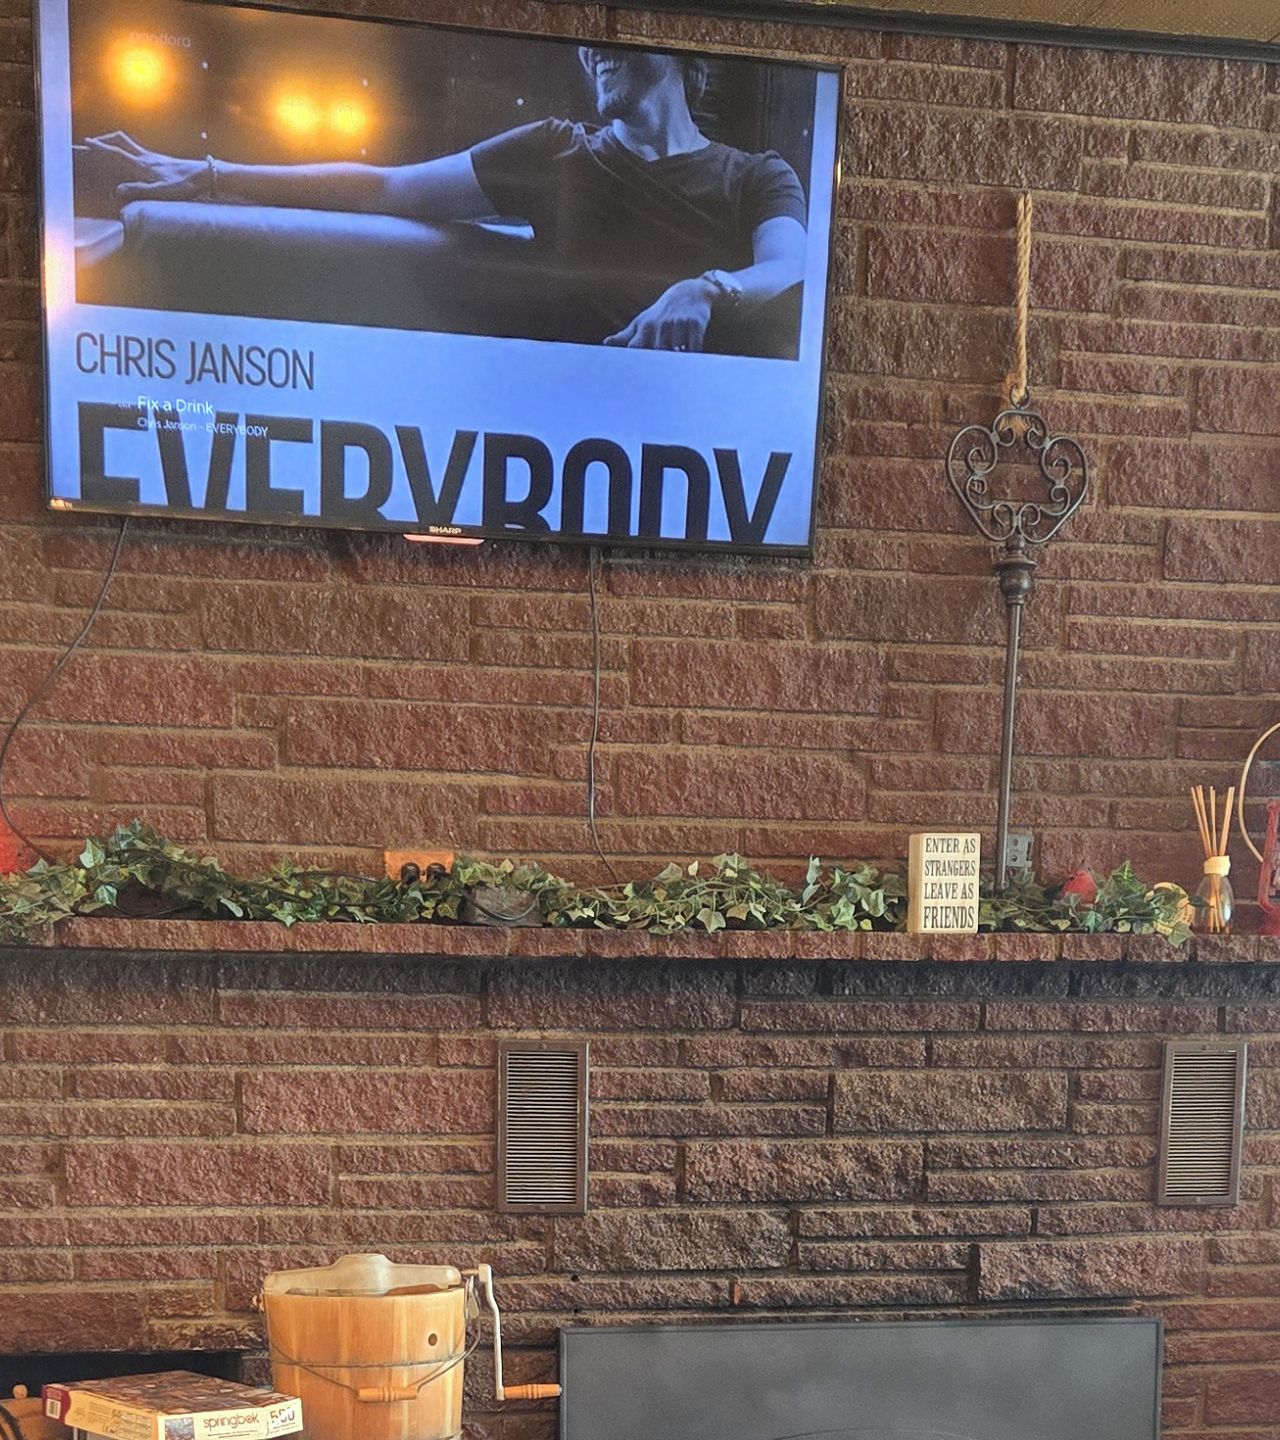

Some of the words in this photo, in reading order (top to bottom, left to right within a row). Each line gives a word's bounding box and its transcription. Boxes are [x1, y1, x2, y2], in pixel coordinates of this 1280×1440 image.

[76, 332, 176, 379] CHRIS
[185, 340, 315, 391] JANSON
[137, 395, 159, 411] Fix
[163, 400, 172, 412] a
[176, 398, 214, 415] Drink
[137, 417, 162, 429] Chris
[163, 418, 196, 431] Janson
[206, 423, 269, 439] EVERYBODY
[77, 400, 792, 545] EVERYBODY
[429, 525, 462, 535] SHARP
[925, 837, 960, 853] ENTER
[963, 838, 976, 853] AS
[924, 860, 976, 876] STRANGERS
[924, 882, 958, 899] LEAVE
[960, 882, 974, 899] AS
[923, 905, 975, 928] FRIENDS
[203, 1413, 260, 1431] springbok
